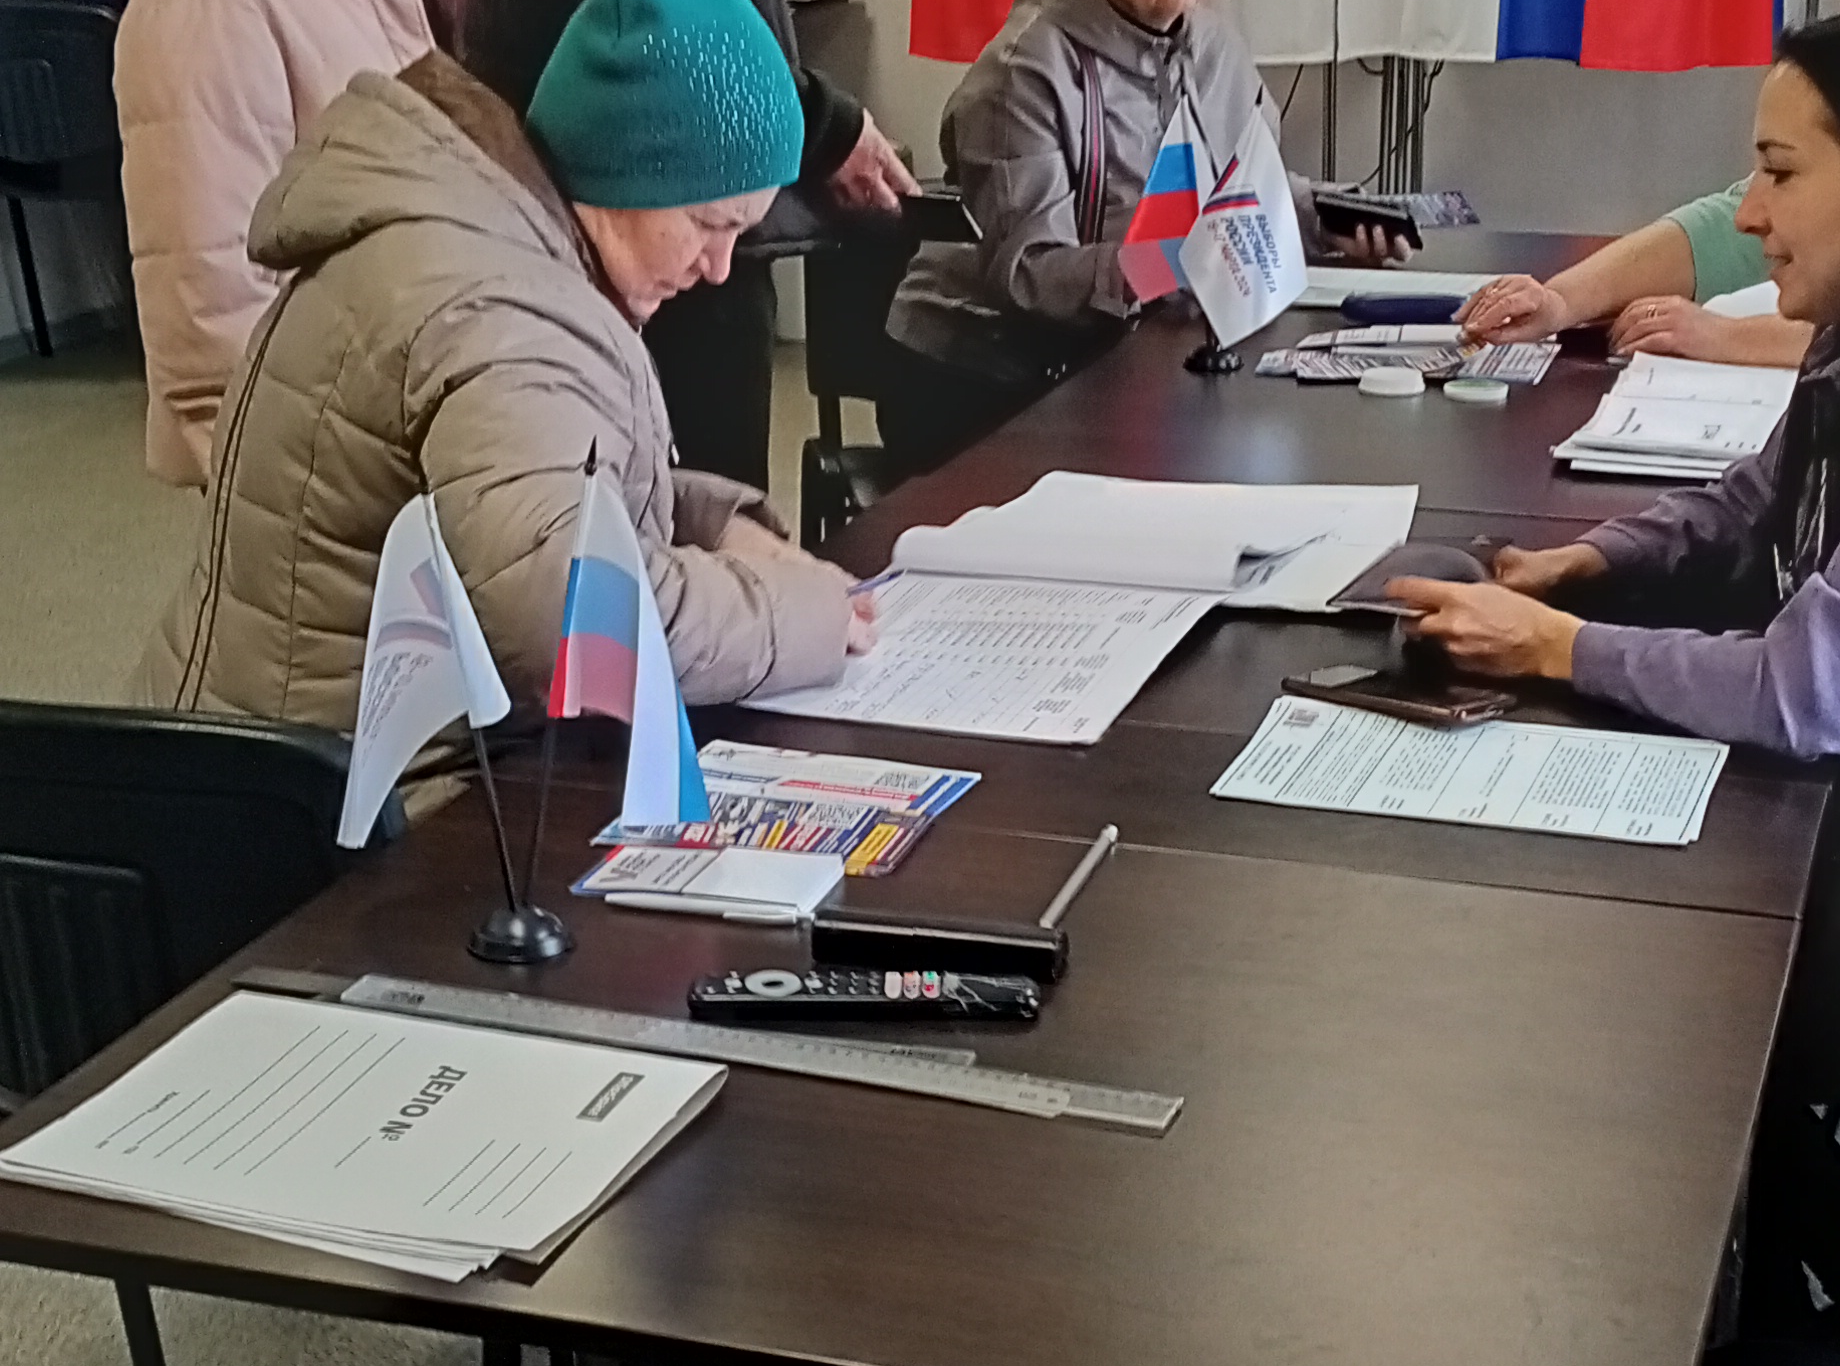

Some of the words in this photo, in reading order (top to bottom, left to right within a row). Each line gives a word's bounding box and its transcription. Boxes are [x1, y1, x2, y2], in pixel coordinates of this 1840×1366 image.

[1238, 214, 1277, 294] ПРЕЗИДЕНТА
[1255, 213, 1282, 269] ВЫБОРЫ
[399, 1065, 468, 1118] ДЕЛО
[378, 1120, 413, 1142] №
